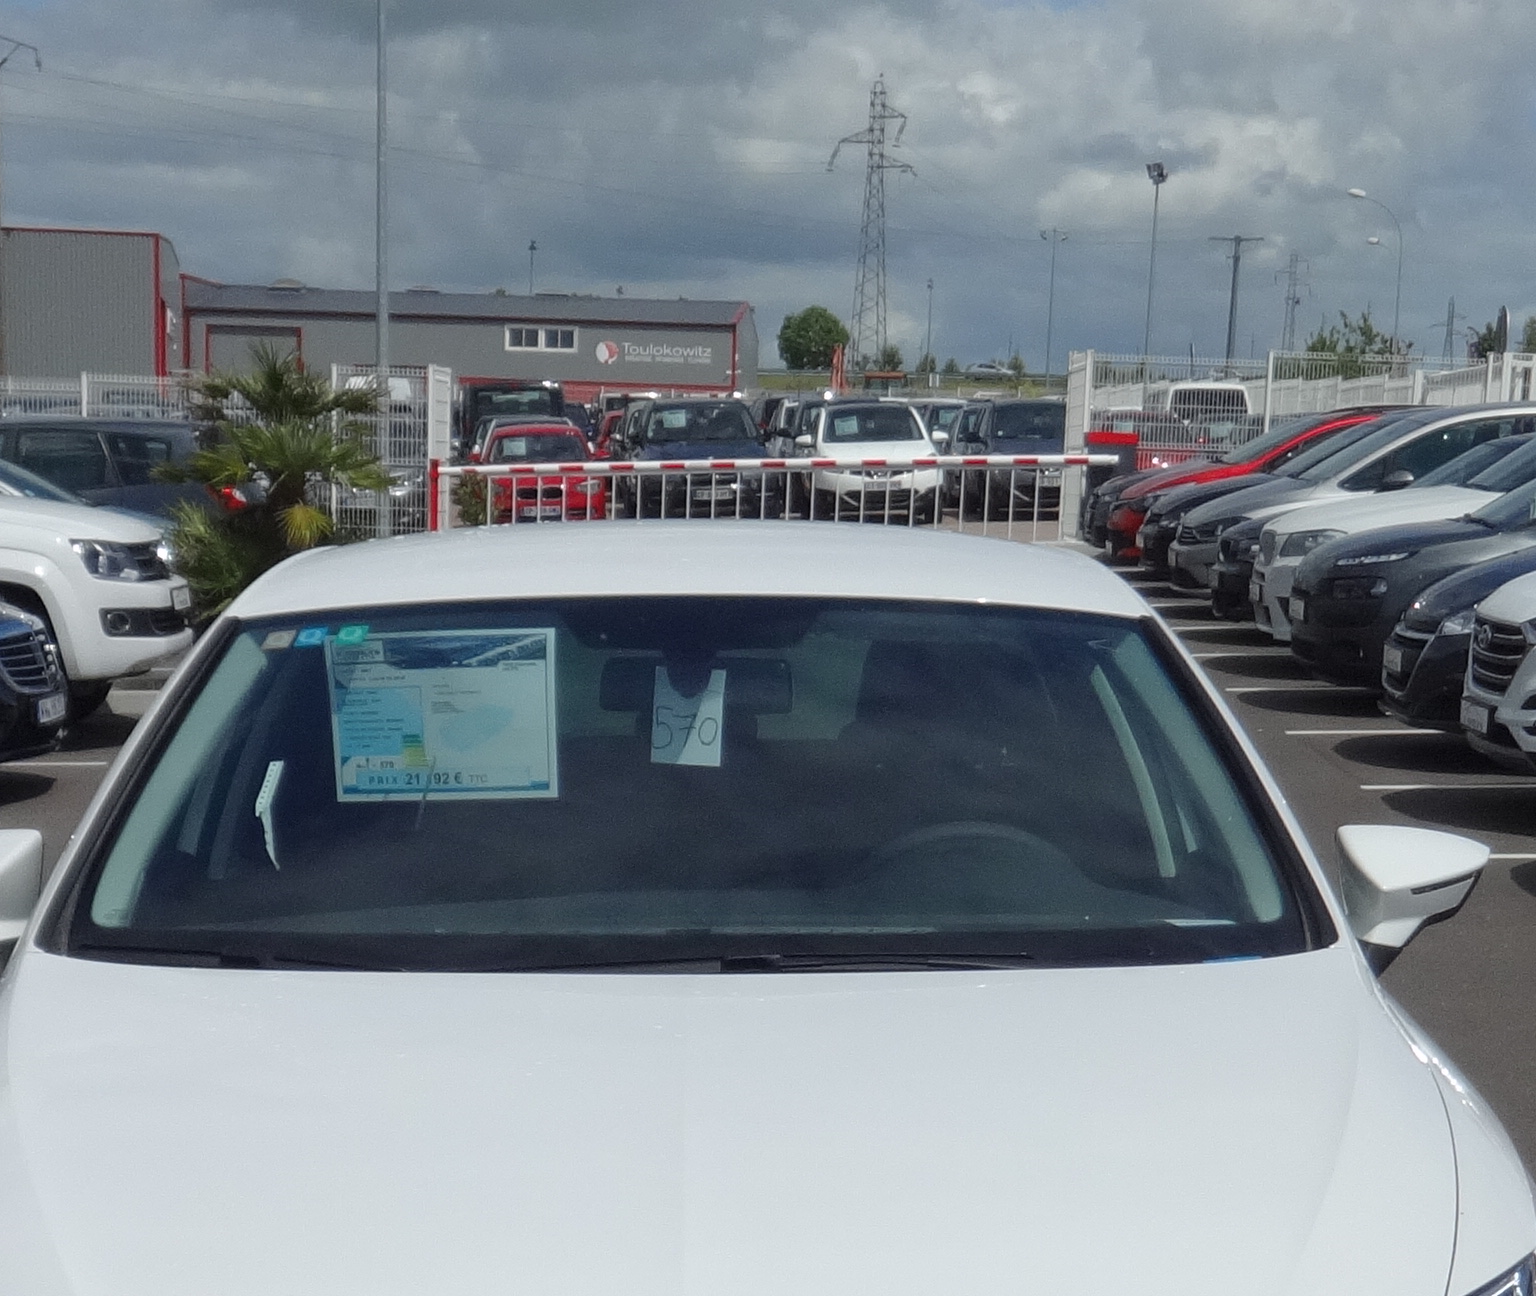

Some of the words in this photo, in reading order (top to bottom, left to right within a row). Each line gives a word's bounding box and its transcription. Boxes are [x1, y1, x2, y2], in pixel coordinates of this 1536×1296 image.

[623, 342, 712, 357] Toulokowitz
[653, 706, 718, 749] 570
[368, 775, 397, 785] PRIX
[405, 773, 420, 785] 21
